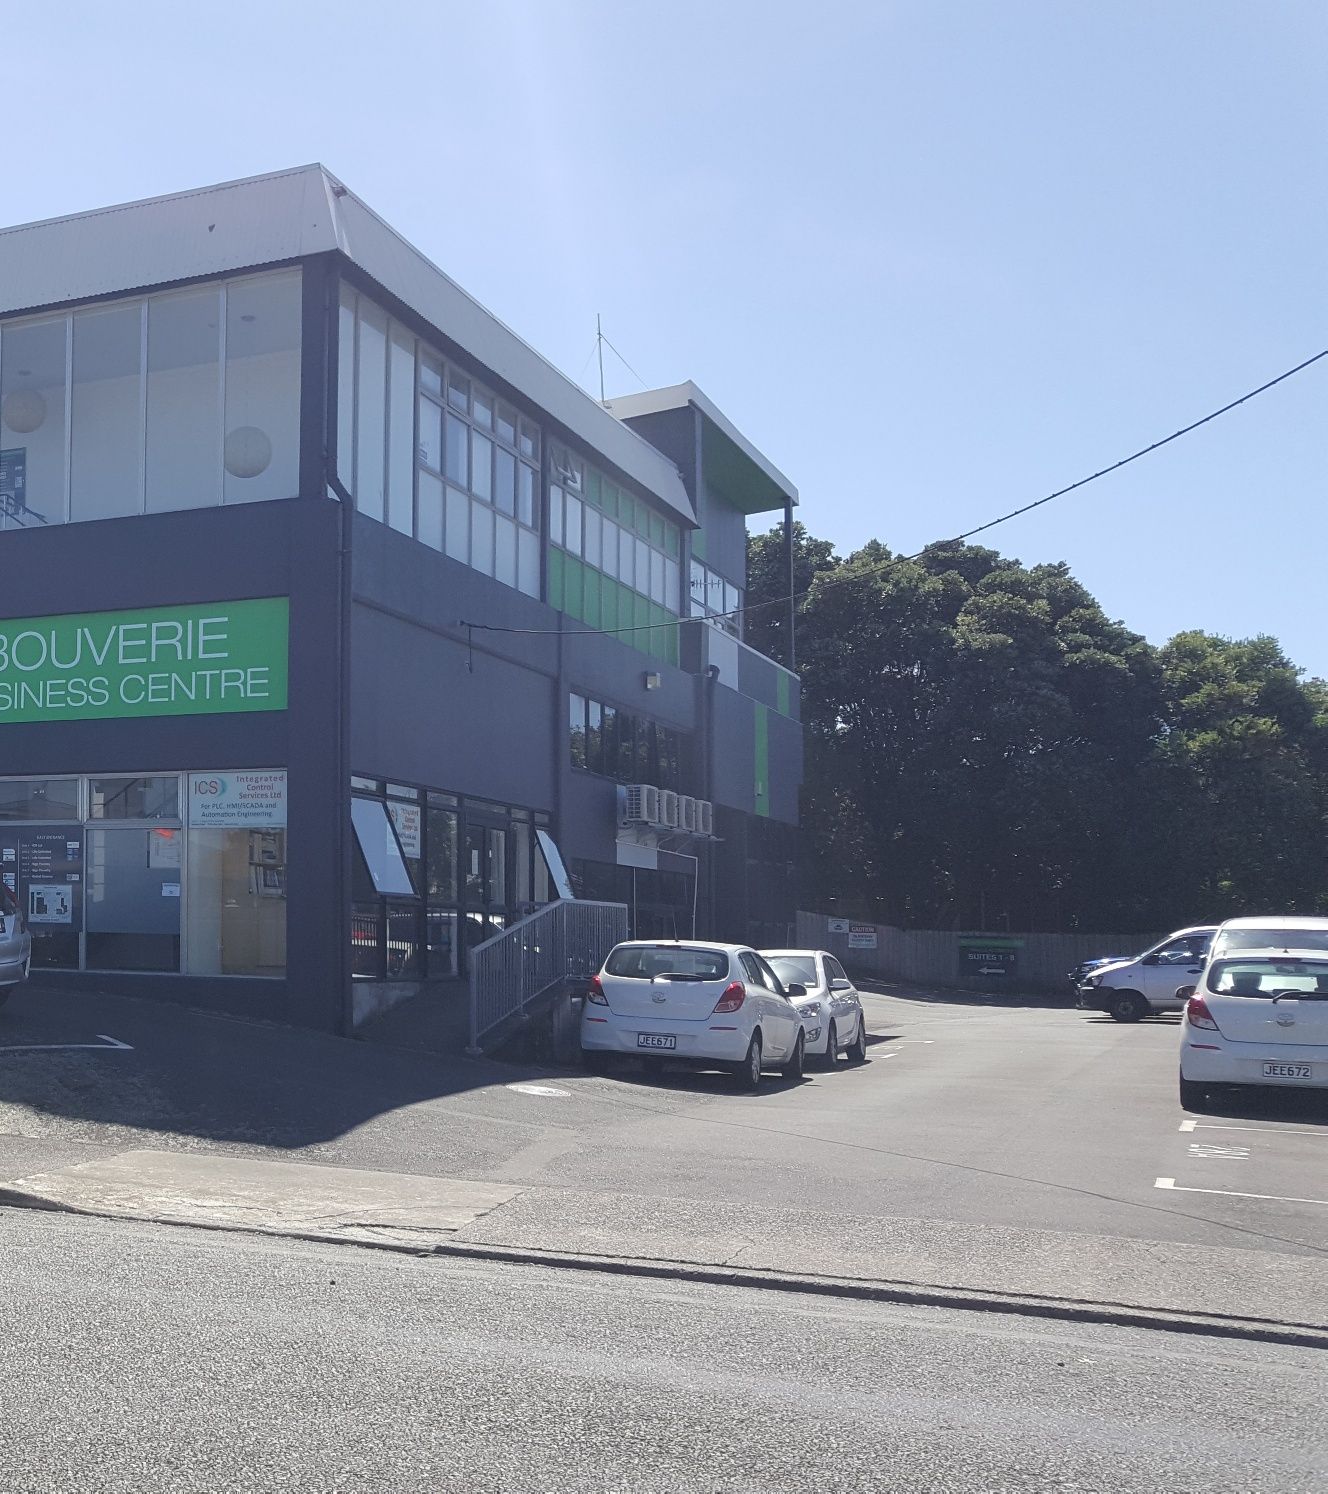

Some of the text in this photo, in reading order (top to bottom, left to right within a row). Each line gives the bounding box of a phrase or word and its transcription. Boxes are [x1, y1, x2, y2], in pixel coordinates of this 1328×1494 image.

[119, 667, 270, 705] CENTRE
[236, 775, 284, 784] Integrated
[194, 780, 218, 795] ICS
[246, 783, 274, 791] Control
[239, 791, 282, 800] Services Ltd
[639, 1036, 674, 1047] JEE671
[1265, 1065, 1310, 1077] JEE672
